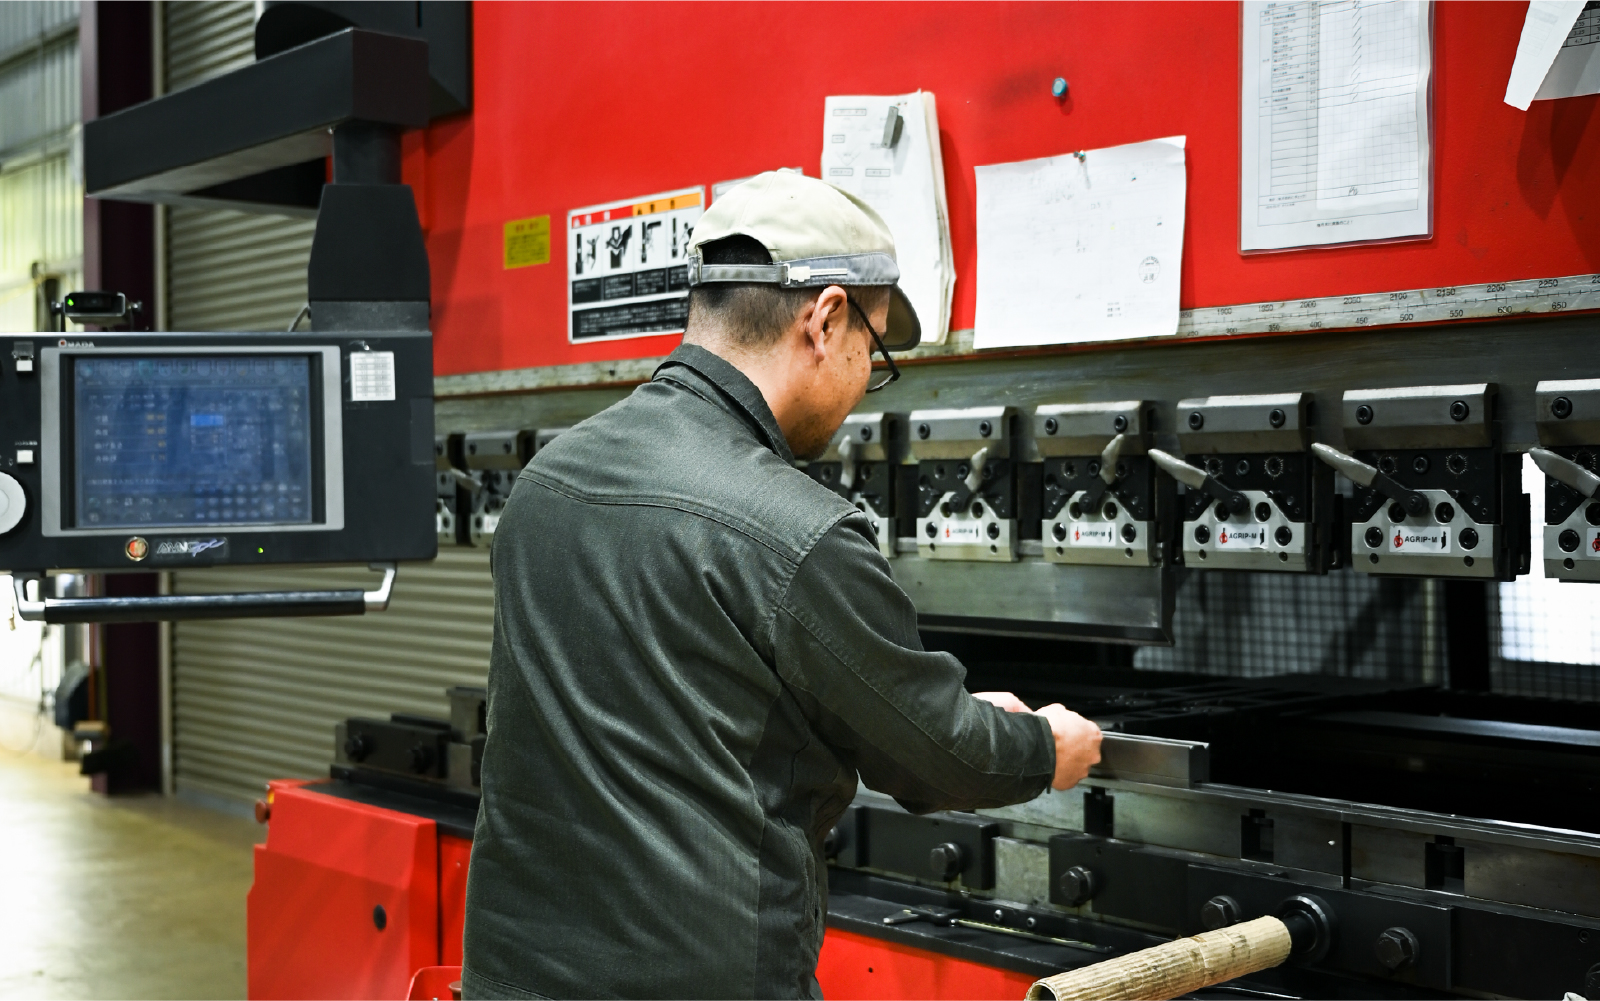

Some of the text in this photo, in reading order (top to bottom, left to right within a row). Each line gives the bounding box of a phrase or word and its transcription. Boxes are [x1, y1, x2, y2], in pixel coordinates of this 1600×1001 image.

[1258, 304, 1274, 312] 1950
[1300, 300, 1316, 308] 2000
[1343, 297, 1361, 305] 2050
[1436, 288, 1456, 297] 2150
[1486, 284, 1506, 293] 2200
[1538, 279, 1559, 288] 2250
[1268, 324, 1280, 332] 350
[1400, 313, 1414, 321] 500
[1450, 309, 1464, 318] 550
[1497, 306, 1512, 314] 600
[1552, 301, 1567, 309] 650
[1404, 535, 1438, 543] AGRIP-M
